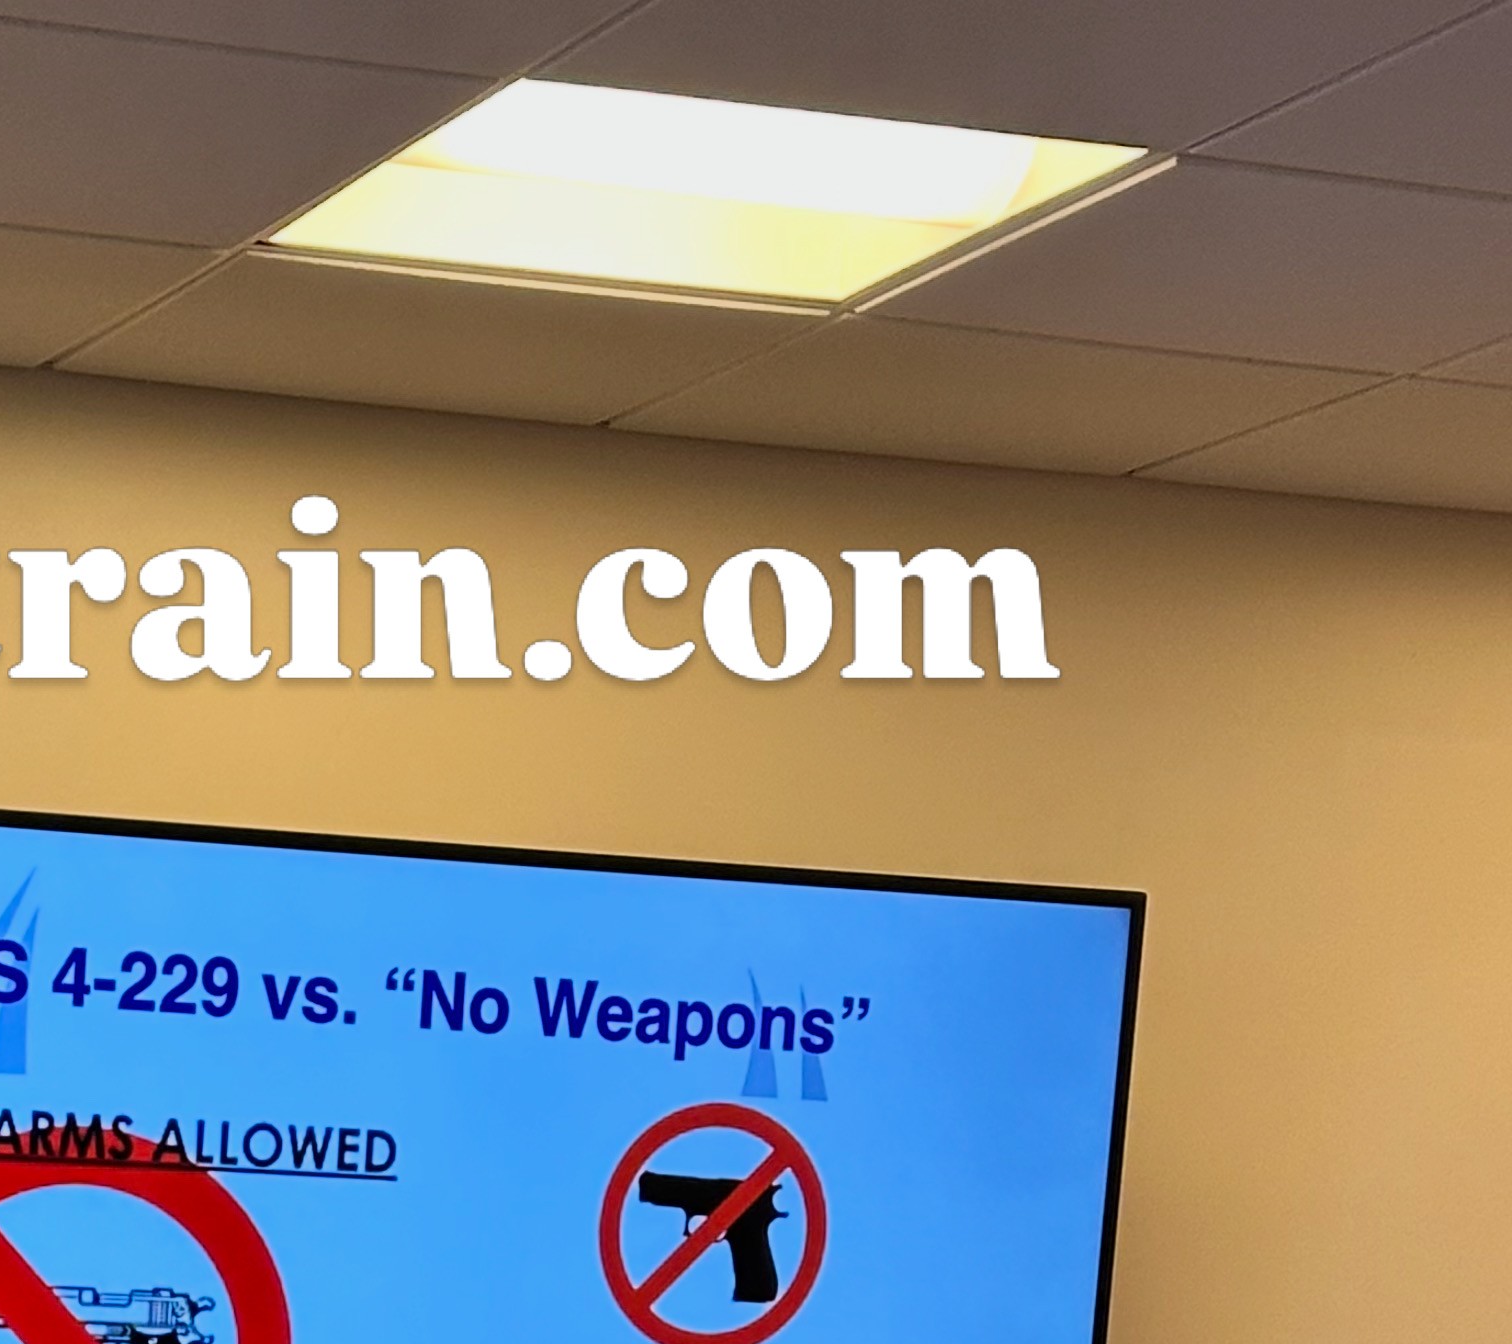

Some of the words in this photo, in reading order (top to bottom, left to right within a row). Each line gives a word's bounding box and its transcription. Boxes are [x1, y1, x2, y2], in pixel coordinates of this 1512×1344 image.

[52, 947, 239, 1018] 4-229
[261, 973, 357, 1024] vs.
[385, 966, 510, 1035] “No
[533, 976, 871, 1061] Weapons”
[151, 1118, 397, 1173] ALLOWED
